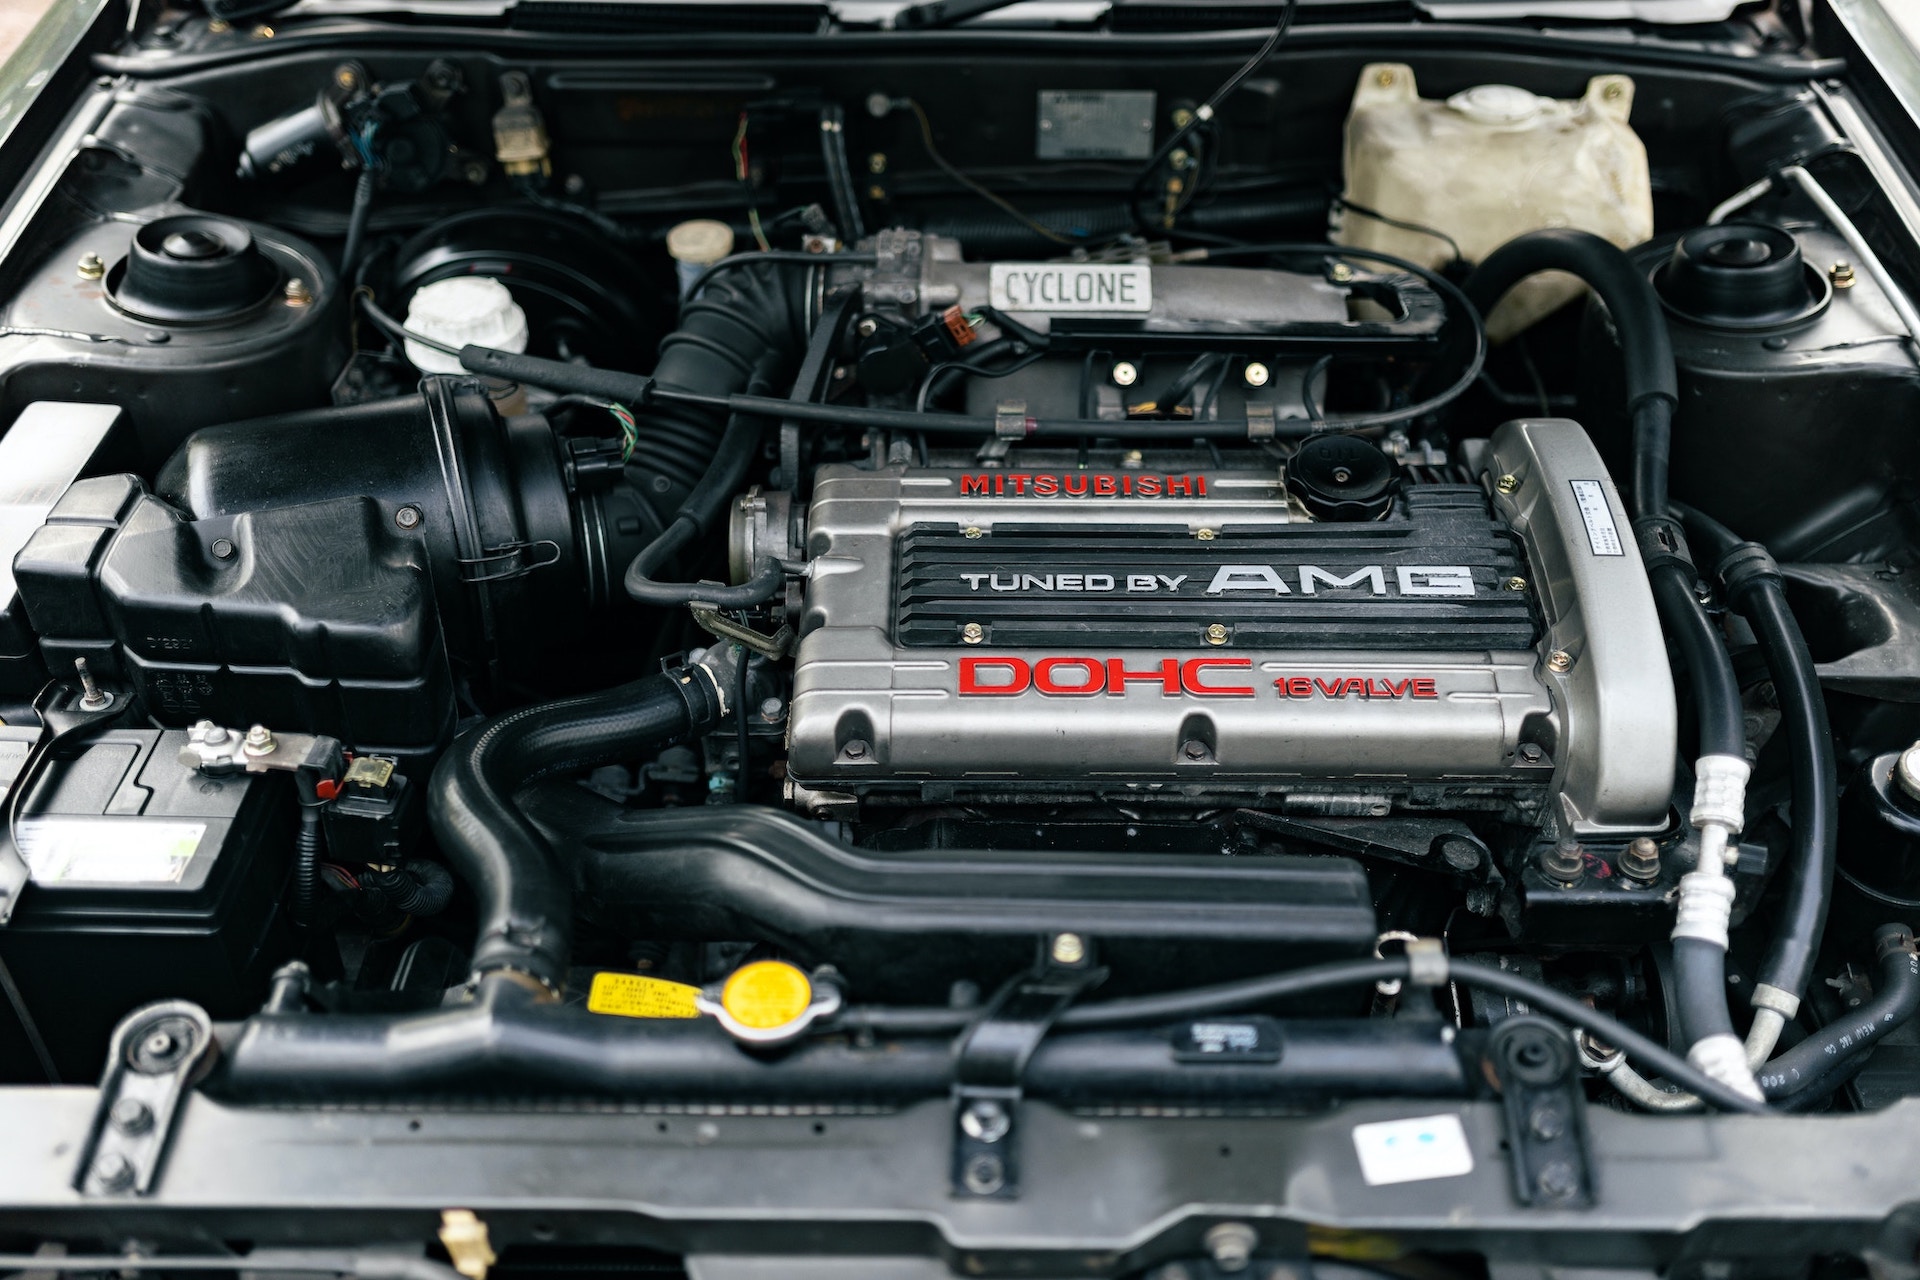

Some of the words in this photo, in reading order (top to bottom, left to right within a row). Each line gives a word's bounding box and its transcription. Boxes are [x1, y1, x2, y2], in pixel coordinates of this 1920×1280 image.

[1005, 272, 1136, 305] CYCLONE
[959, 474, 1209, 498] MITSUBISHI
[960, 573, 1115, 592] TUNED
[1126, 573, 1188, 592] BY
[1205, 565, 1476, 597] AMG
[957, 657, 1256, 697] DOHC
